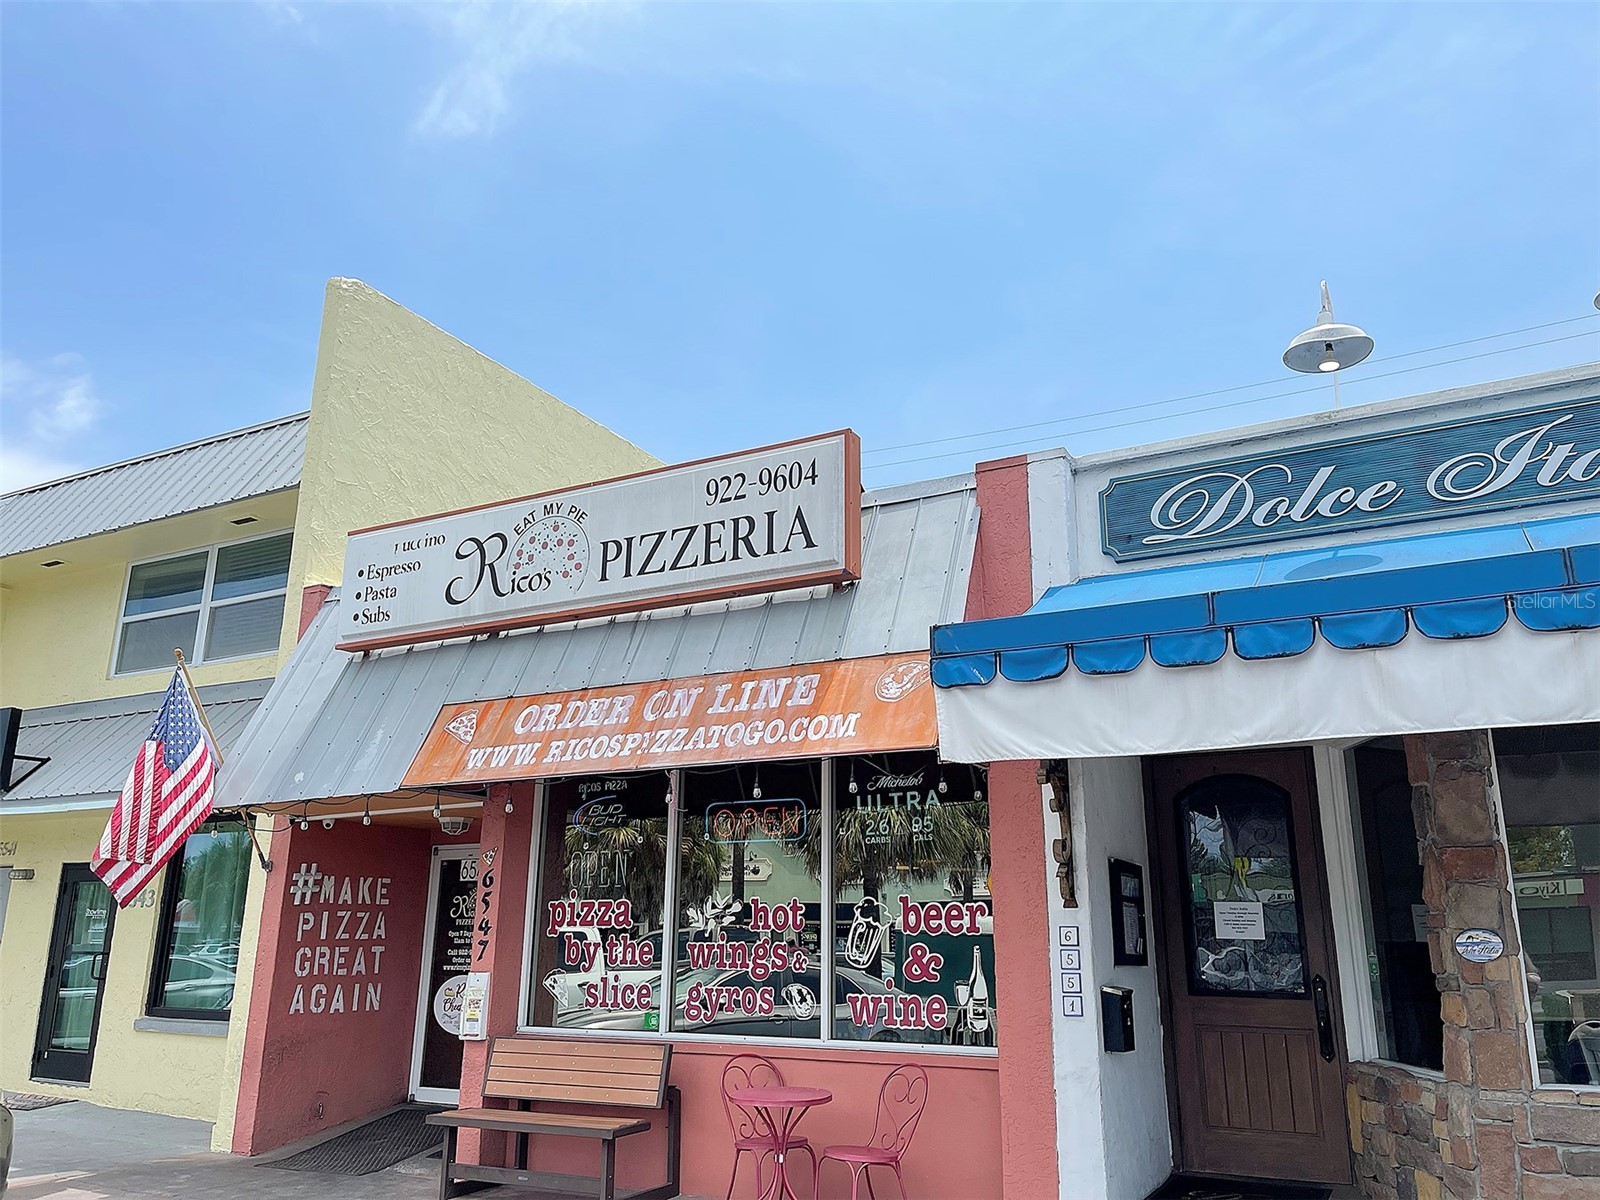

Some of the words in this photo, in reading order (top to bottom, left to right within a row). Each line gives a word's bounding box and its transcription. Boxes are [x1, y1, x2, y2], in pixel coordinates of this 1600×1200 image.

[705, 457, 819, 507] 922-9604
[513, 510, 537, 535] EAT
[543, 502, 563, 517] MY
[567, 505, 588, 525] PIE
[1142, 463, 1404, 545] Dolce
[367, 561, 421, 581] Espresso
[445, 532, 552, 605] Rico's
[597, 505, 819, 582] PIZZERIA
[364, 586, 397, 602] Pasta
[361, 606, 390, 624] Subs
[513, 695, 635, 735] ORDER
[643, 687, 704, 722] ON
[706, 674, 821, 714] LINE
[466, 741, 542, 770] WWW.
[542, 712, 862, 764] RICOSPIZZATOGO.COM
[604, 780, 628, 791] PIZZA
[856, 789, 941, 813] ULTRA
[580, 814, 627, 826] LIGHT
[589, 804, 623, 816] BUD
[714, 806, 799, 838] OPEN
[865, 819, 890, 836] 2.6
[865, 836, 891, 844] CARBS
[290, 863, 391, 905] #MAKE
[461, 860, 479, 880] 65
[570, 850, 630, 889] OPEN
[297, 911, 386, 942] PIZZA
[548, 889, 633, 937] pizza
[749, 896, 806, 933] hot
[898, 894, 989, 936] beer
[294, 946, 387, 977] GREAT
[565, 933, 601, 973] by
[606, 933, 654, 967] the
[686, 931, 789, 981] wings
[791, 951, 809, 973] &
[902, 942, 944, 983] &
[289, 983, 382, 1015] AGAIN
[584, 973, 653, 1010] slice
[684, 981, 775, 1024] gyros
[846, 977, 948, 1029] wine
